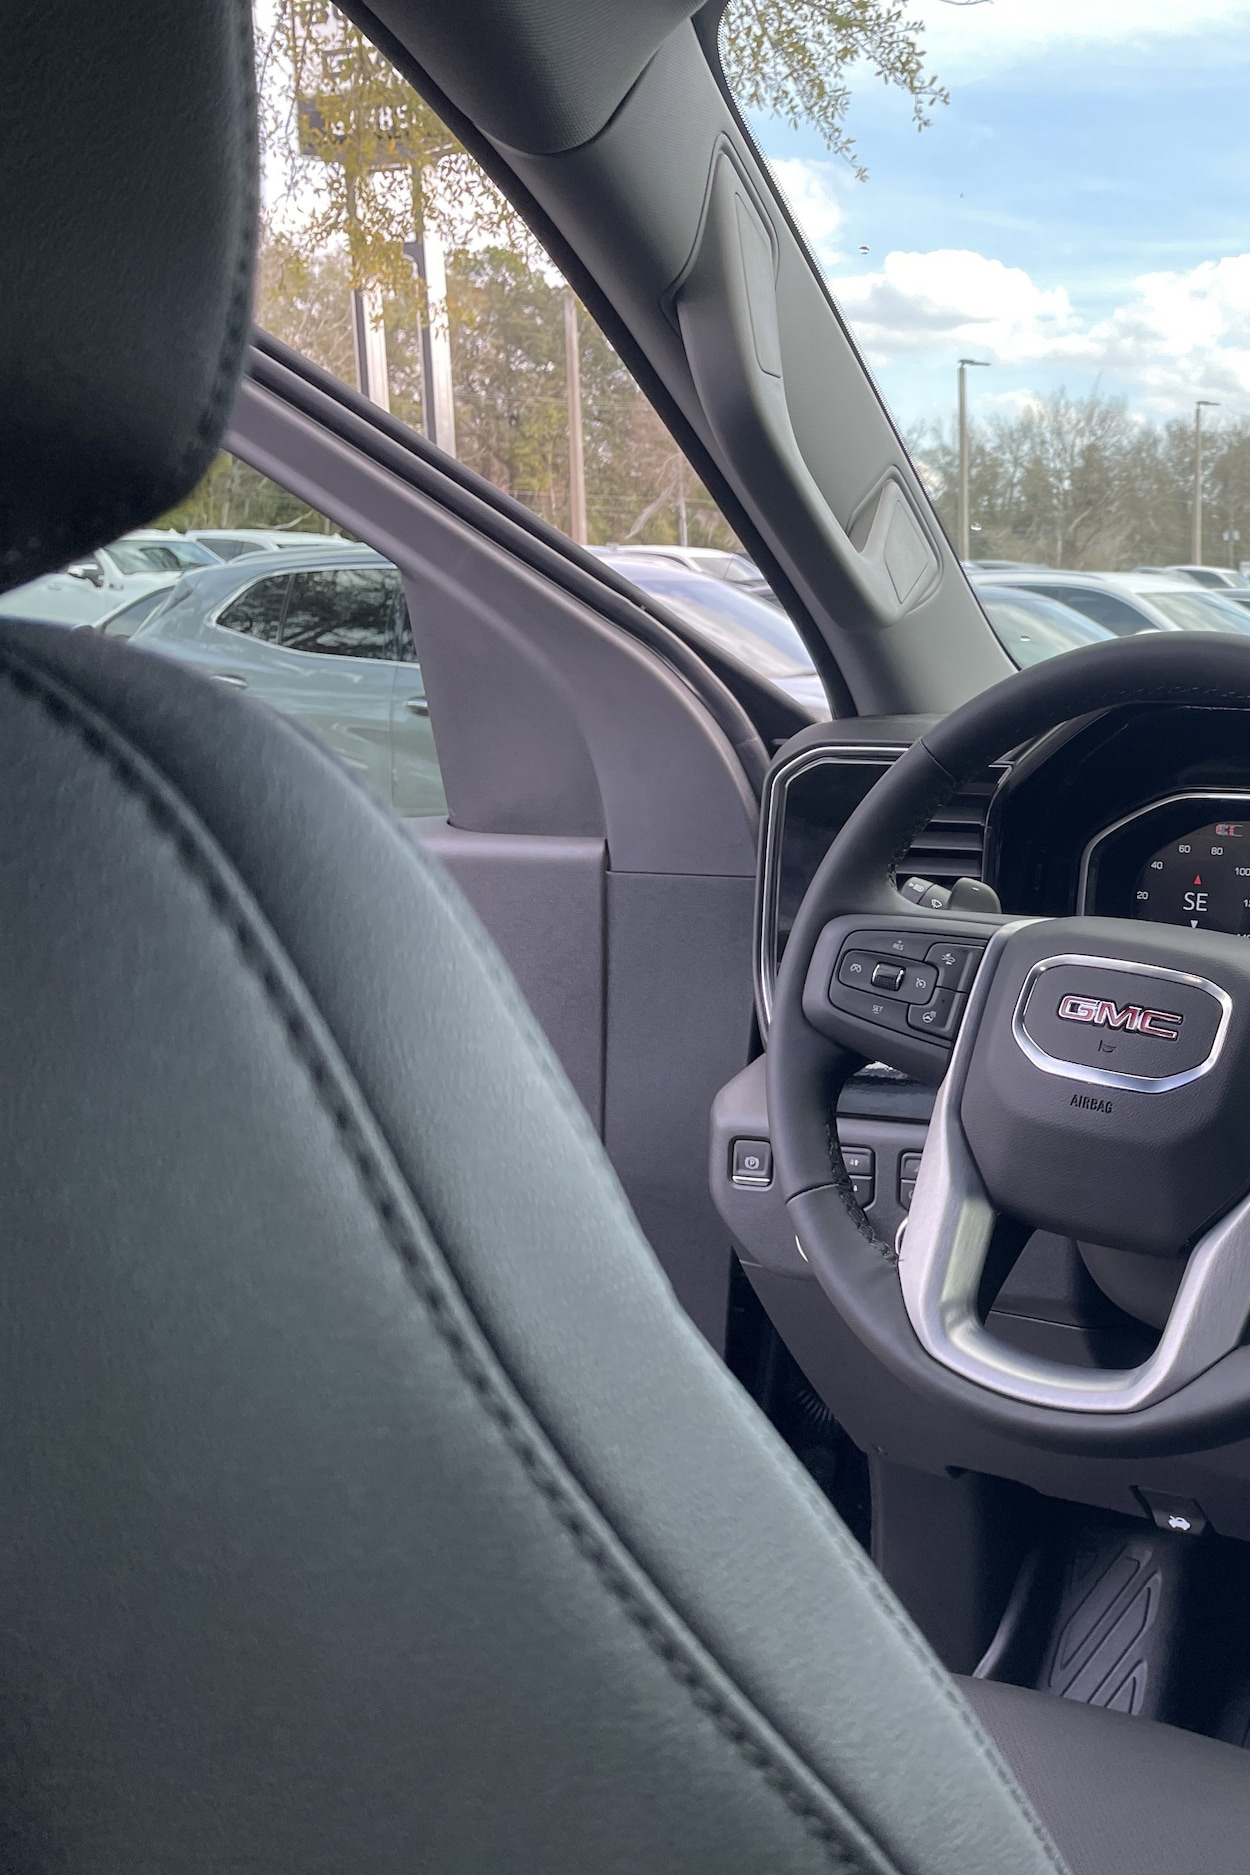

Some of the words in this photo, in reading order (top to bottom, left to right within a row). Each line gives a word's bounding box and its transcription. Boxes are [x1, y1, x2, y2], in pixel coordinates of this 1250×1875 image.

[1179, 845, 1190, 853] 60
[1211, 847, 1223, 855] 80
[1151, 861, 1163, 870] 40
[1235, 867, 1250, 876] 100
[1137, 891, 1148, 899] 20
[1183, 892, 1208, 911] SE
[1059, 994, 1182, 1039] GMC
[1070, 1094, 1113, 1113] AIRBAG
